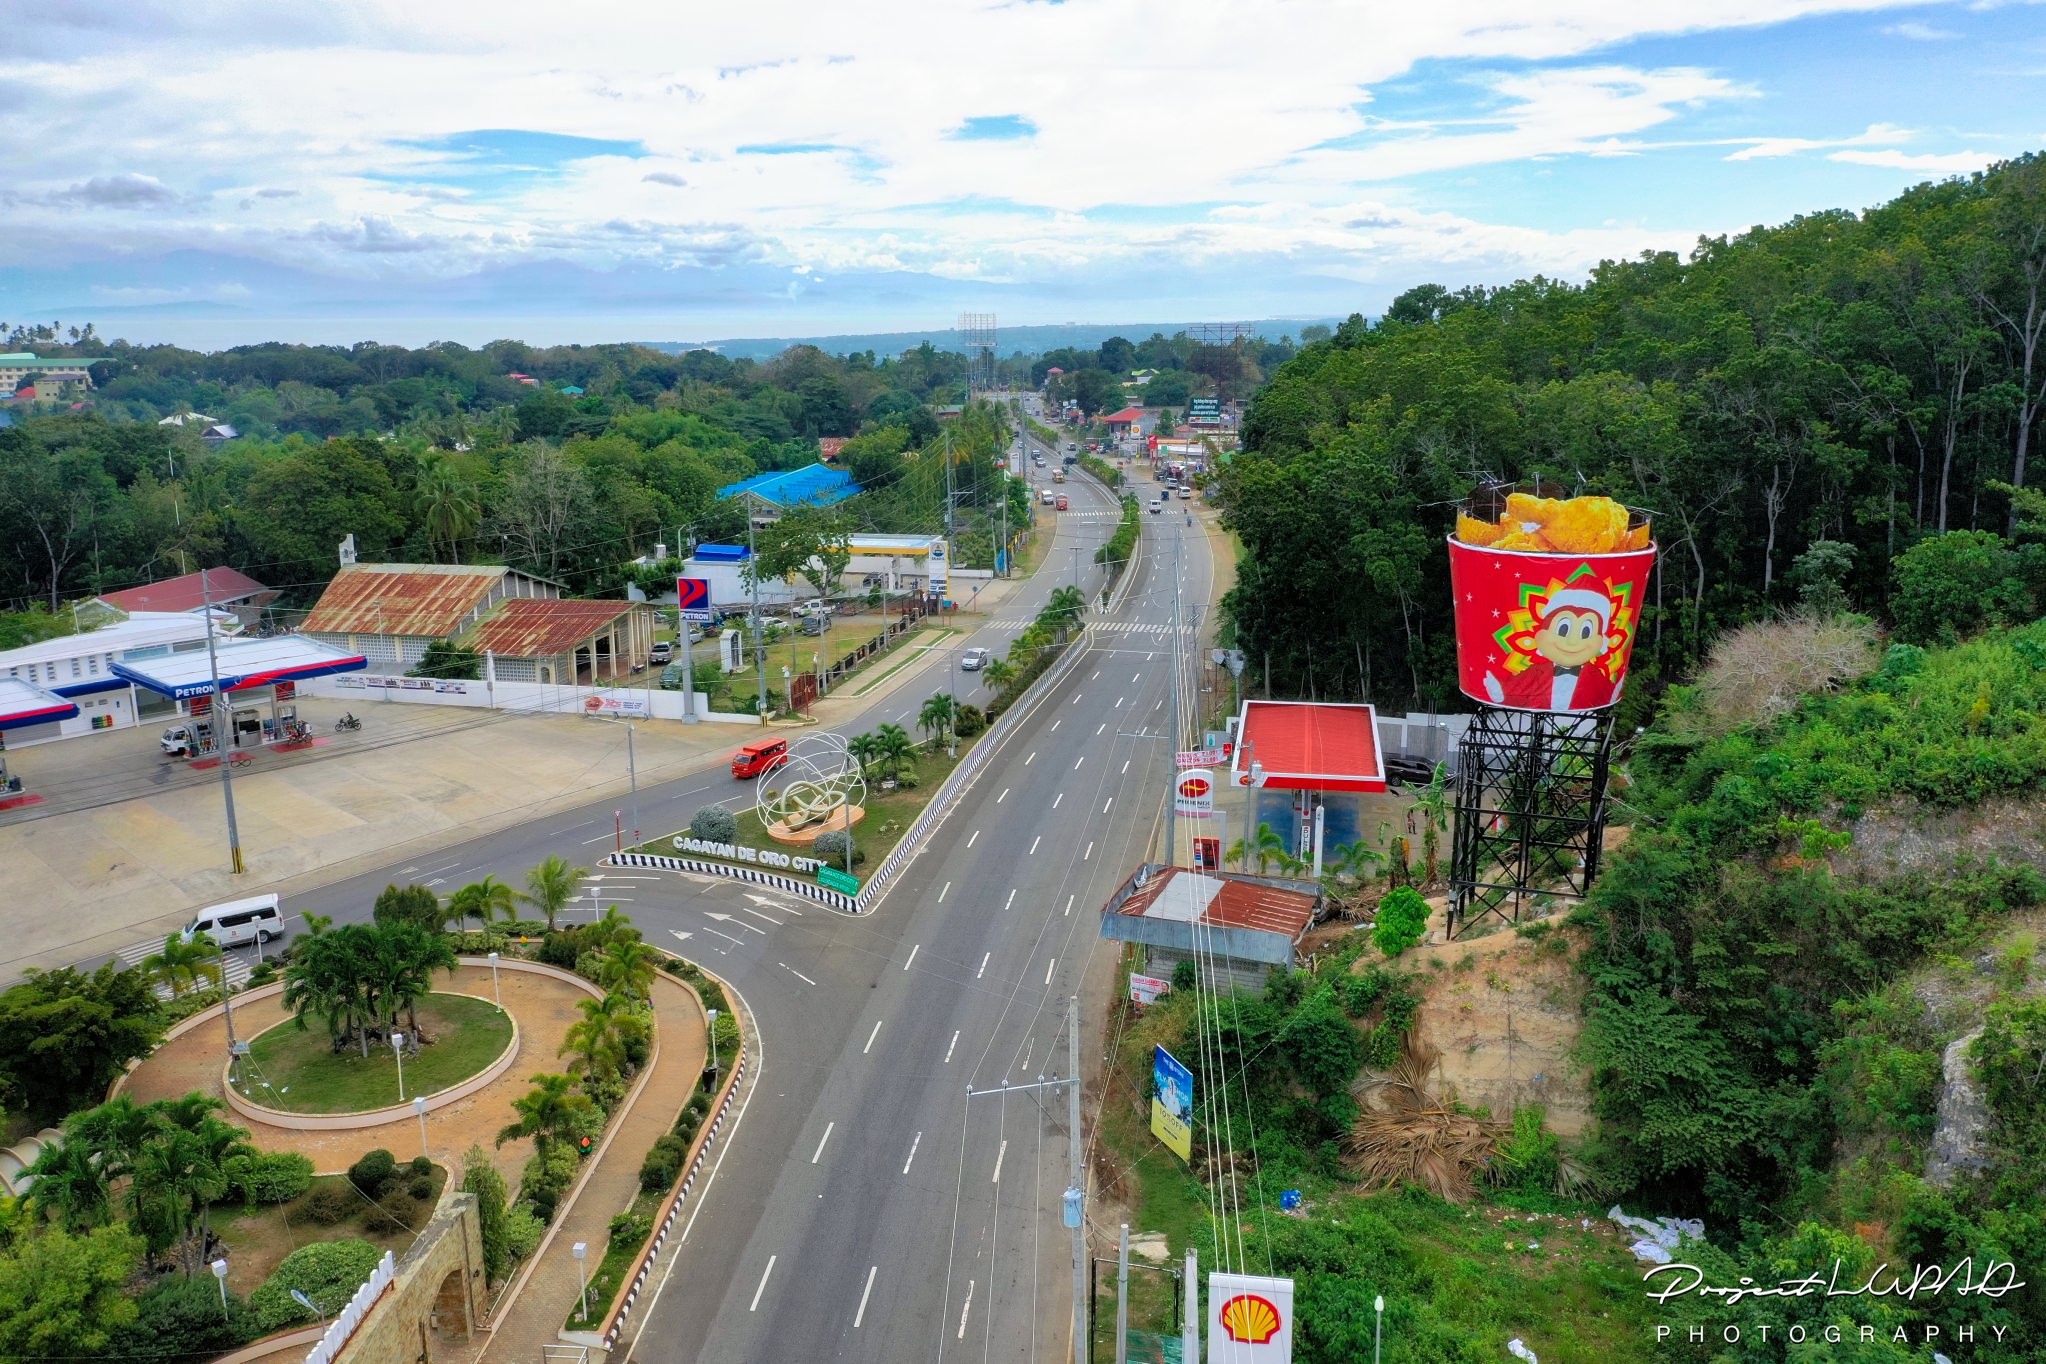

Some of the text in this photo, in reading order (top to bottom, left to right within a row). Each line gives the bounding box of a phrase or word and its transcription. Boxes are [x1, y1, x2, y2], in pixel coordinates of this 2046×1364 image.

[680, 612, 709, 620] PETRON
[672, 836, 828, 872] CAGAYAN DE ORO CITY
